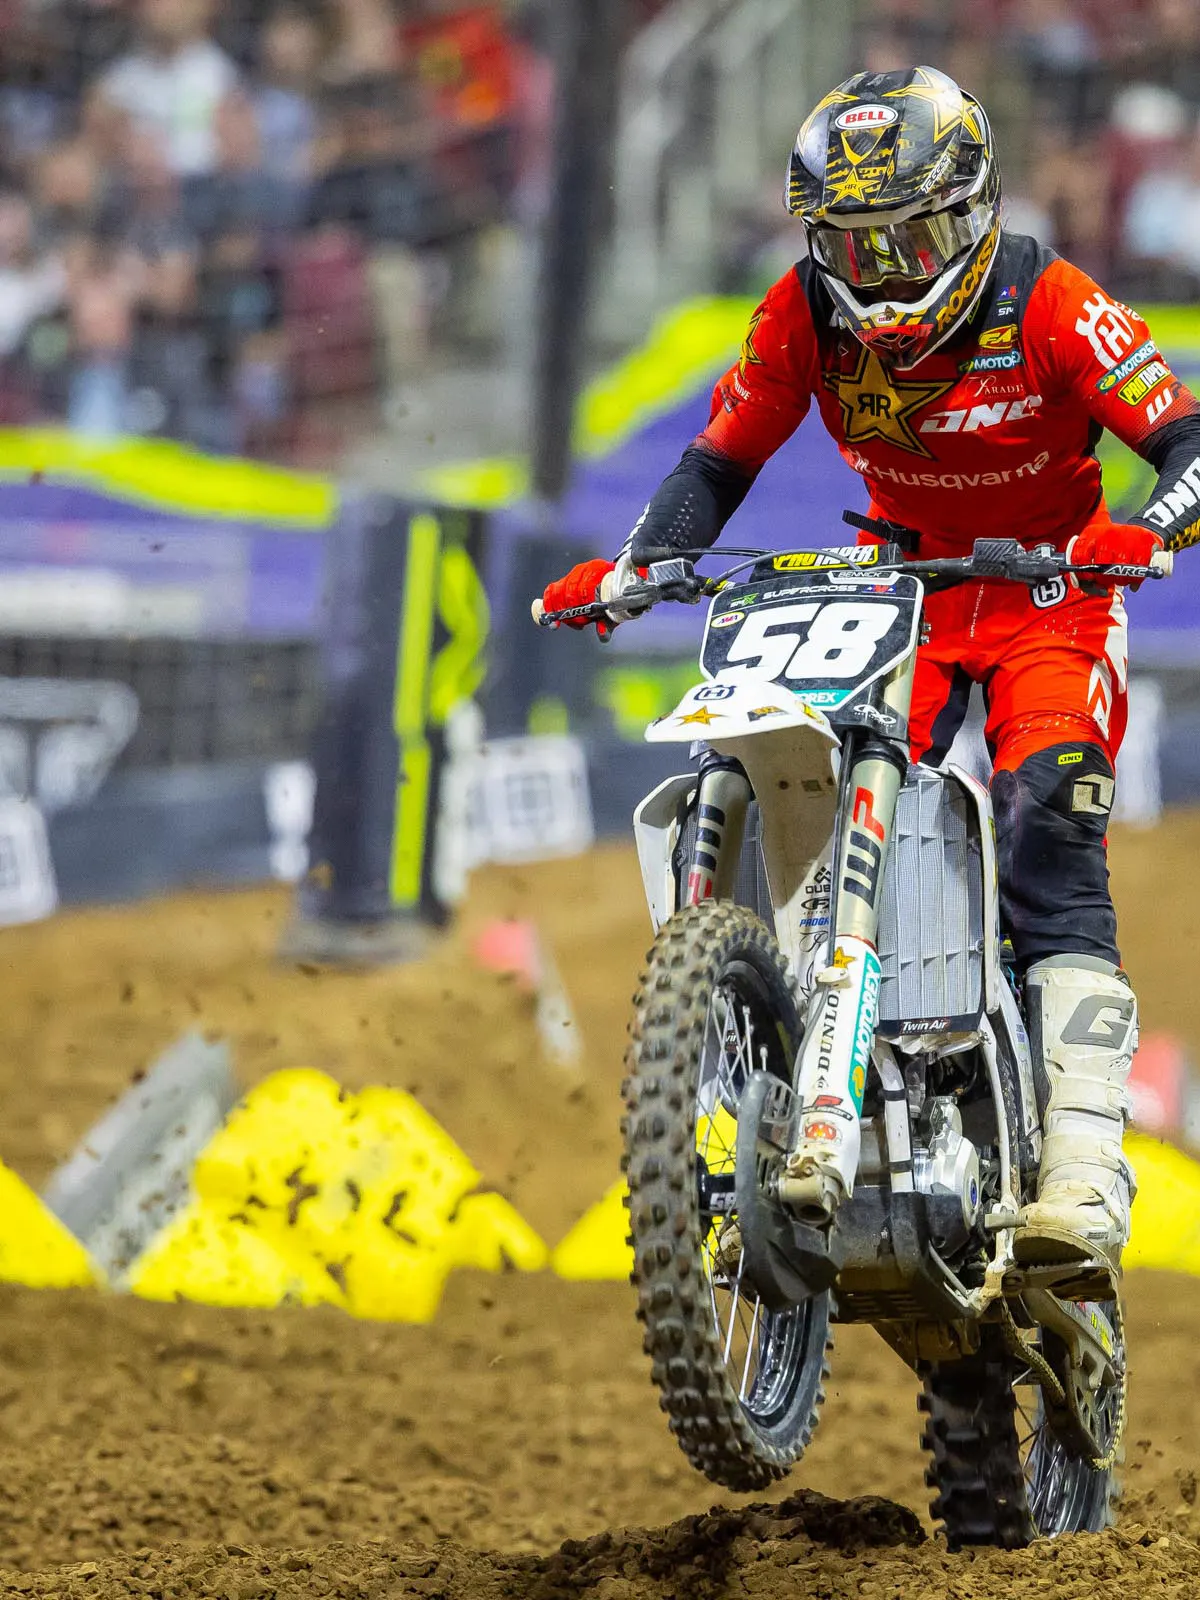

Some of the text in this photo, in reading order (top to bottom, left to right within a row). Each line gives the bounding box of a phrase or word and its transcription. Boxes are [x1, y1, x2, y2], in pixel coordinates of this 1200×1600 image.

[845, 111, 887, 124] BELL
[872, 451, 1050, 490] Husqvarna
[1103, 565, 1148, 577] ARC
[762, 585, 858, 600] SUPERCROSS
[559, 603, 592, 619] ARC
[715, 602, 899, 682] 58
[853, 963, 881, 1066] MOTOREX
[818, 991, 840, 1072] DUNLO
[903, 1019, 947, 1031] Twin Air
